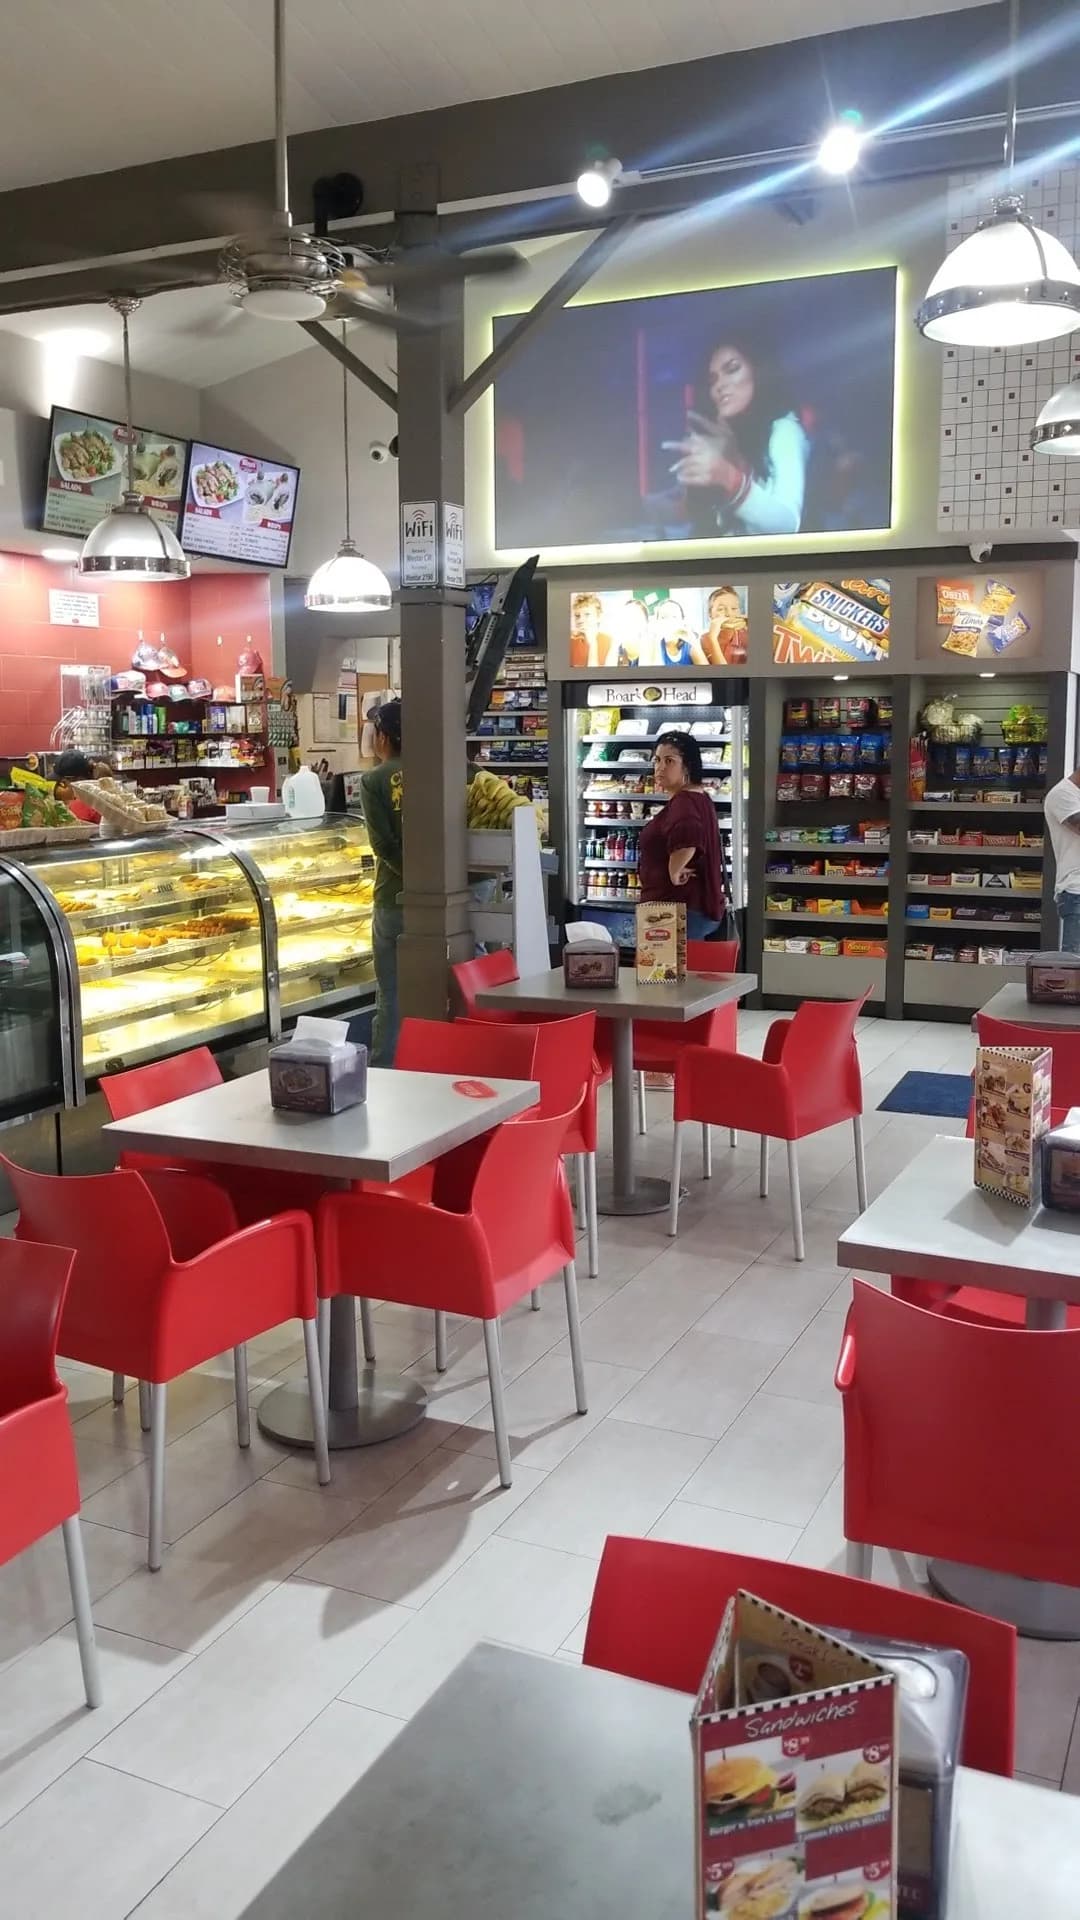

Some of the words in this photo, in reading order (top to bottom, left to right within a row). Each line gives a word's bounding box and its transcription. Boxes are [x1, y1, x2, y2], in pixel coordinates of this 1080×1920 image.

[405, 520, 433, 538] WiFi
[814, 589, 889, 633] SNICKERS
[606, 687, 641, 702] Boar's
[663, 686, 697, 701] Head
[745, 1700, 858, 1738] Sandwiches
